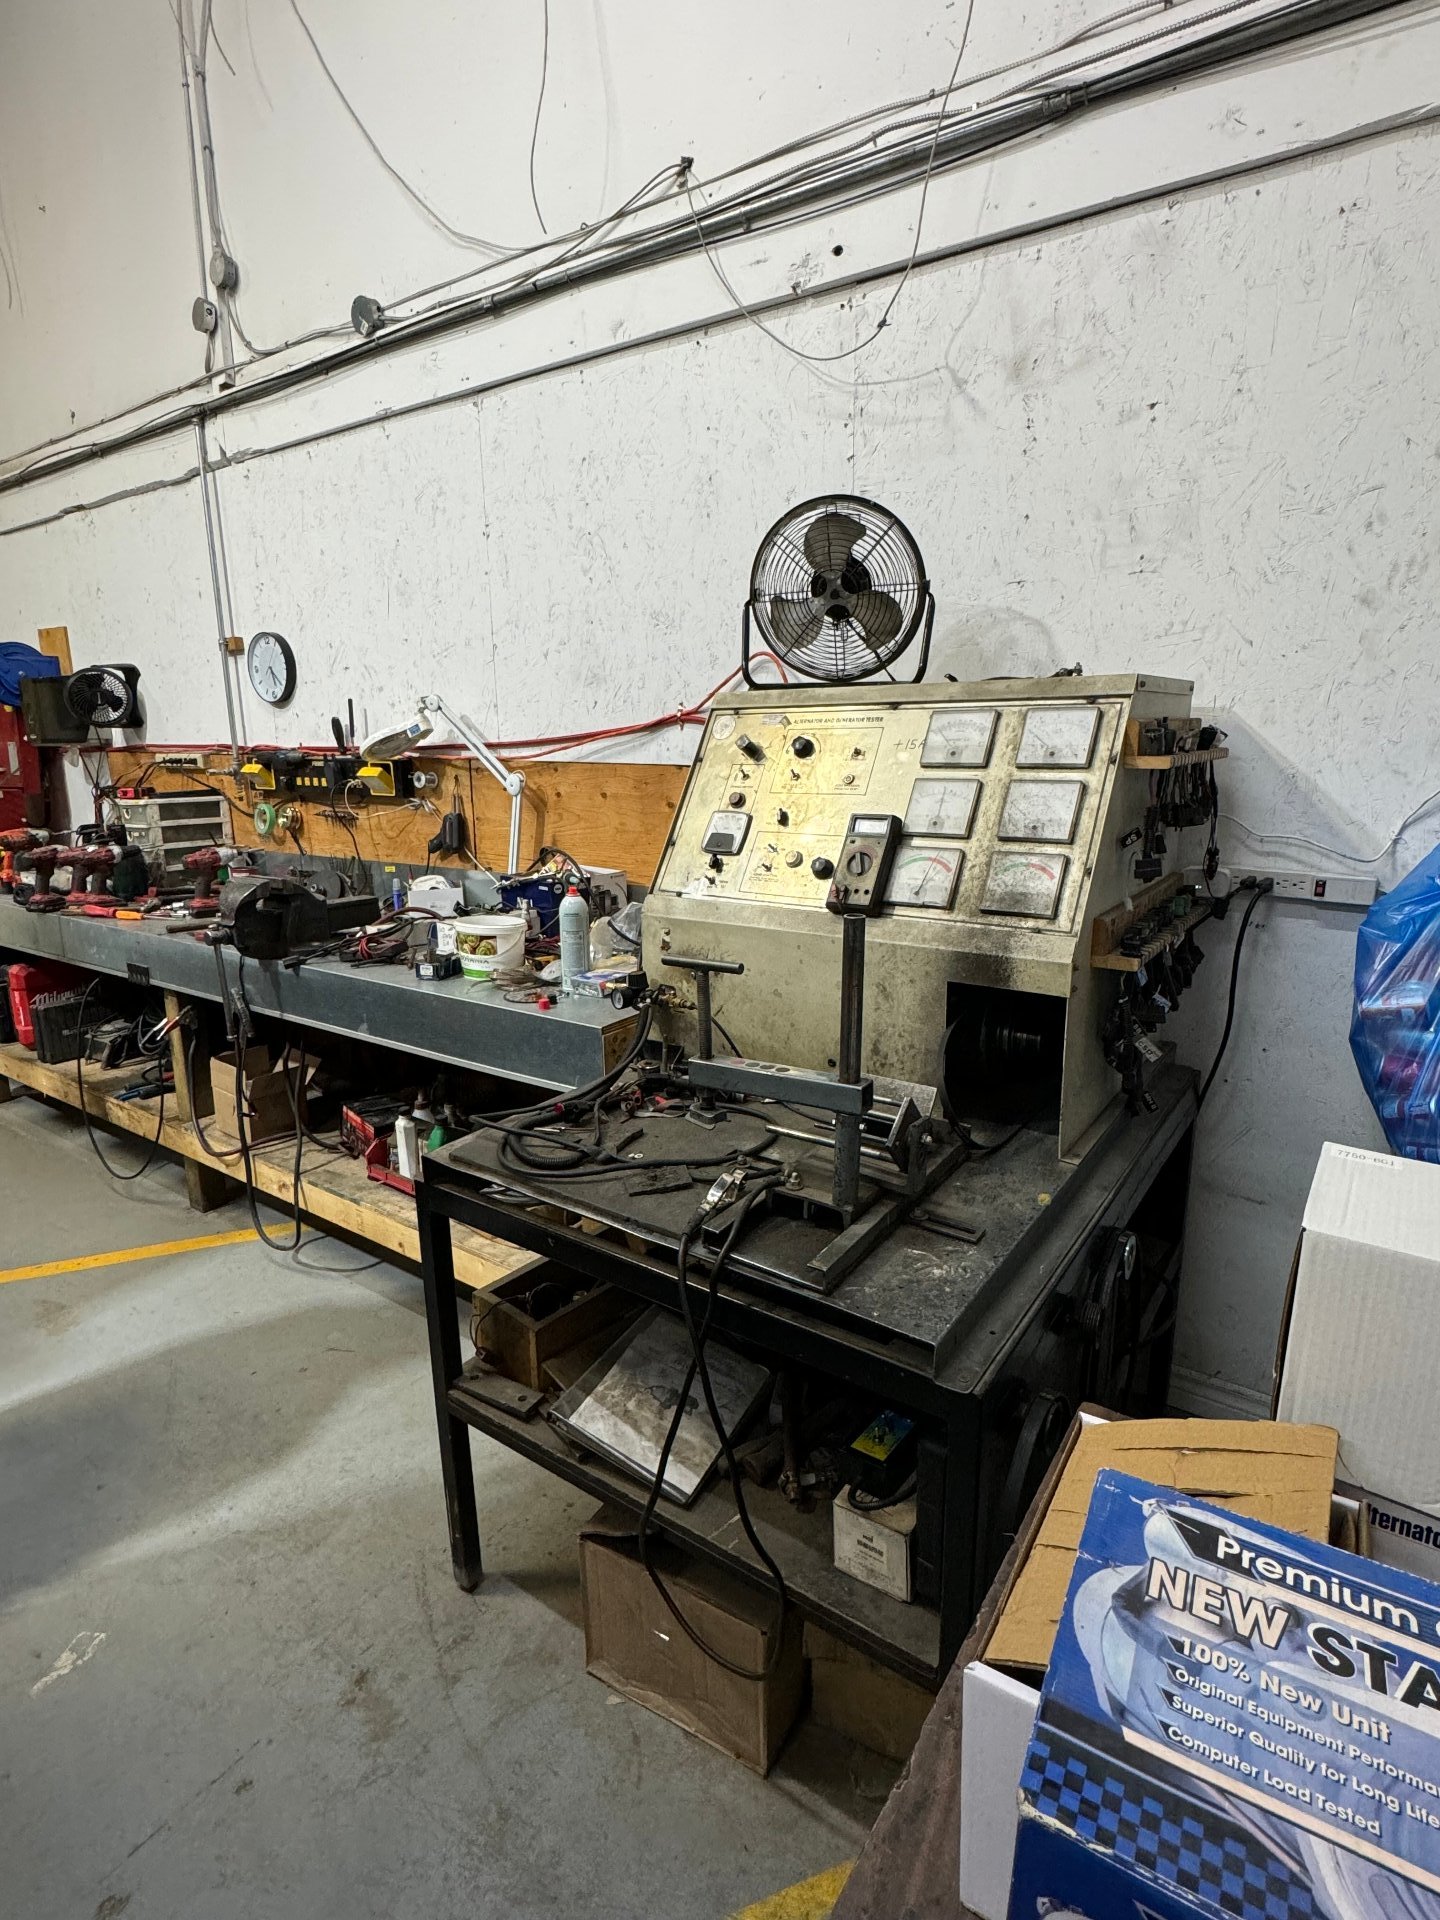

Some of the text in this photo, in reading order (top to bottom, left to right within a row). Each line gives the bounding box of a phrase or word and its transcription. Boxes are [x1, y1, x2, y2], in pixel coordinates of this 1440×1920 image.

[264, 636, 270, 645] 12
[1146, 1556, 1440, 1712] NEW STA
[1216, 1535, 1420, 1635] Premium
[1175, 1668, 1440, 1799] Original Equipment Performa
[1181, 1636, 1392, 1745] 100% New Unit
[1167, 1726, 1382, 1838] Computer Load Tested
[1171, 1694, 1440, 1829] Superior Quality for Long Life
